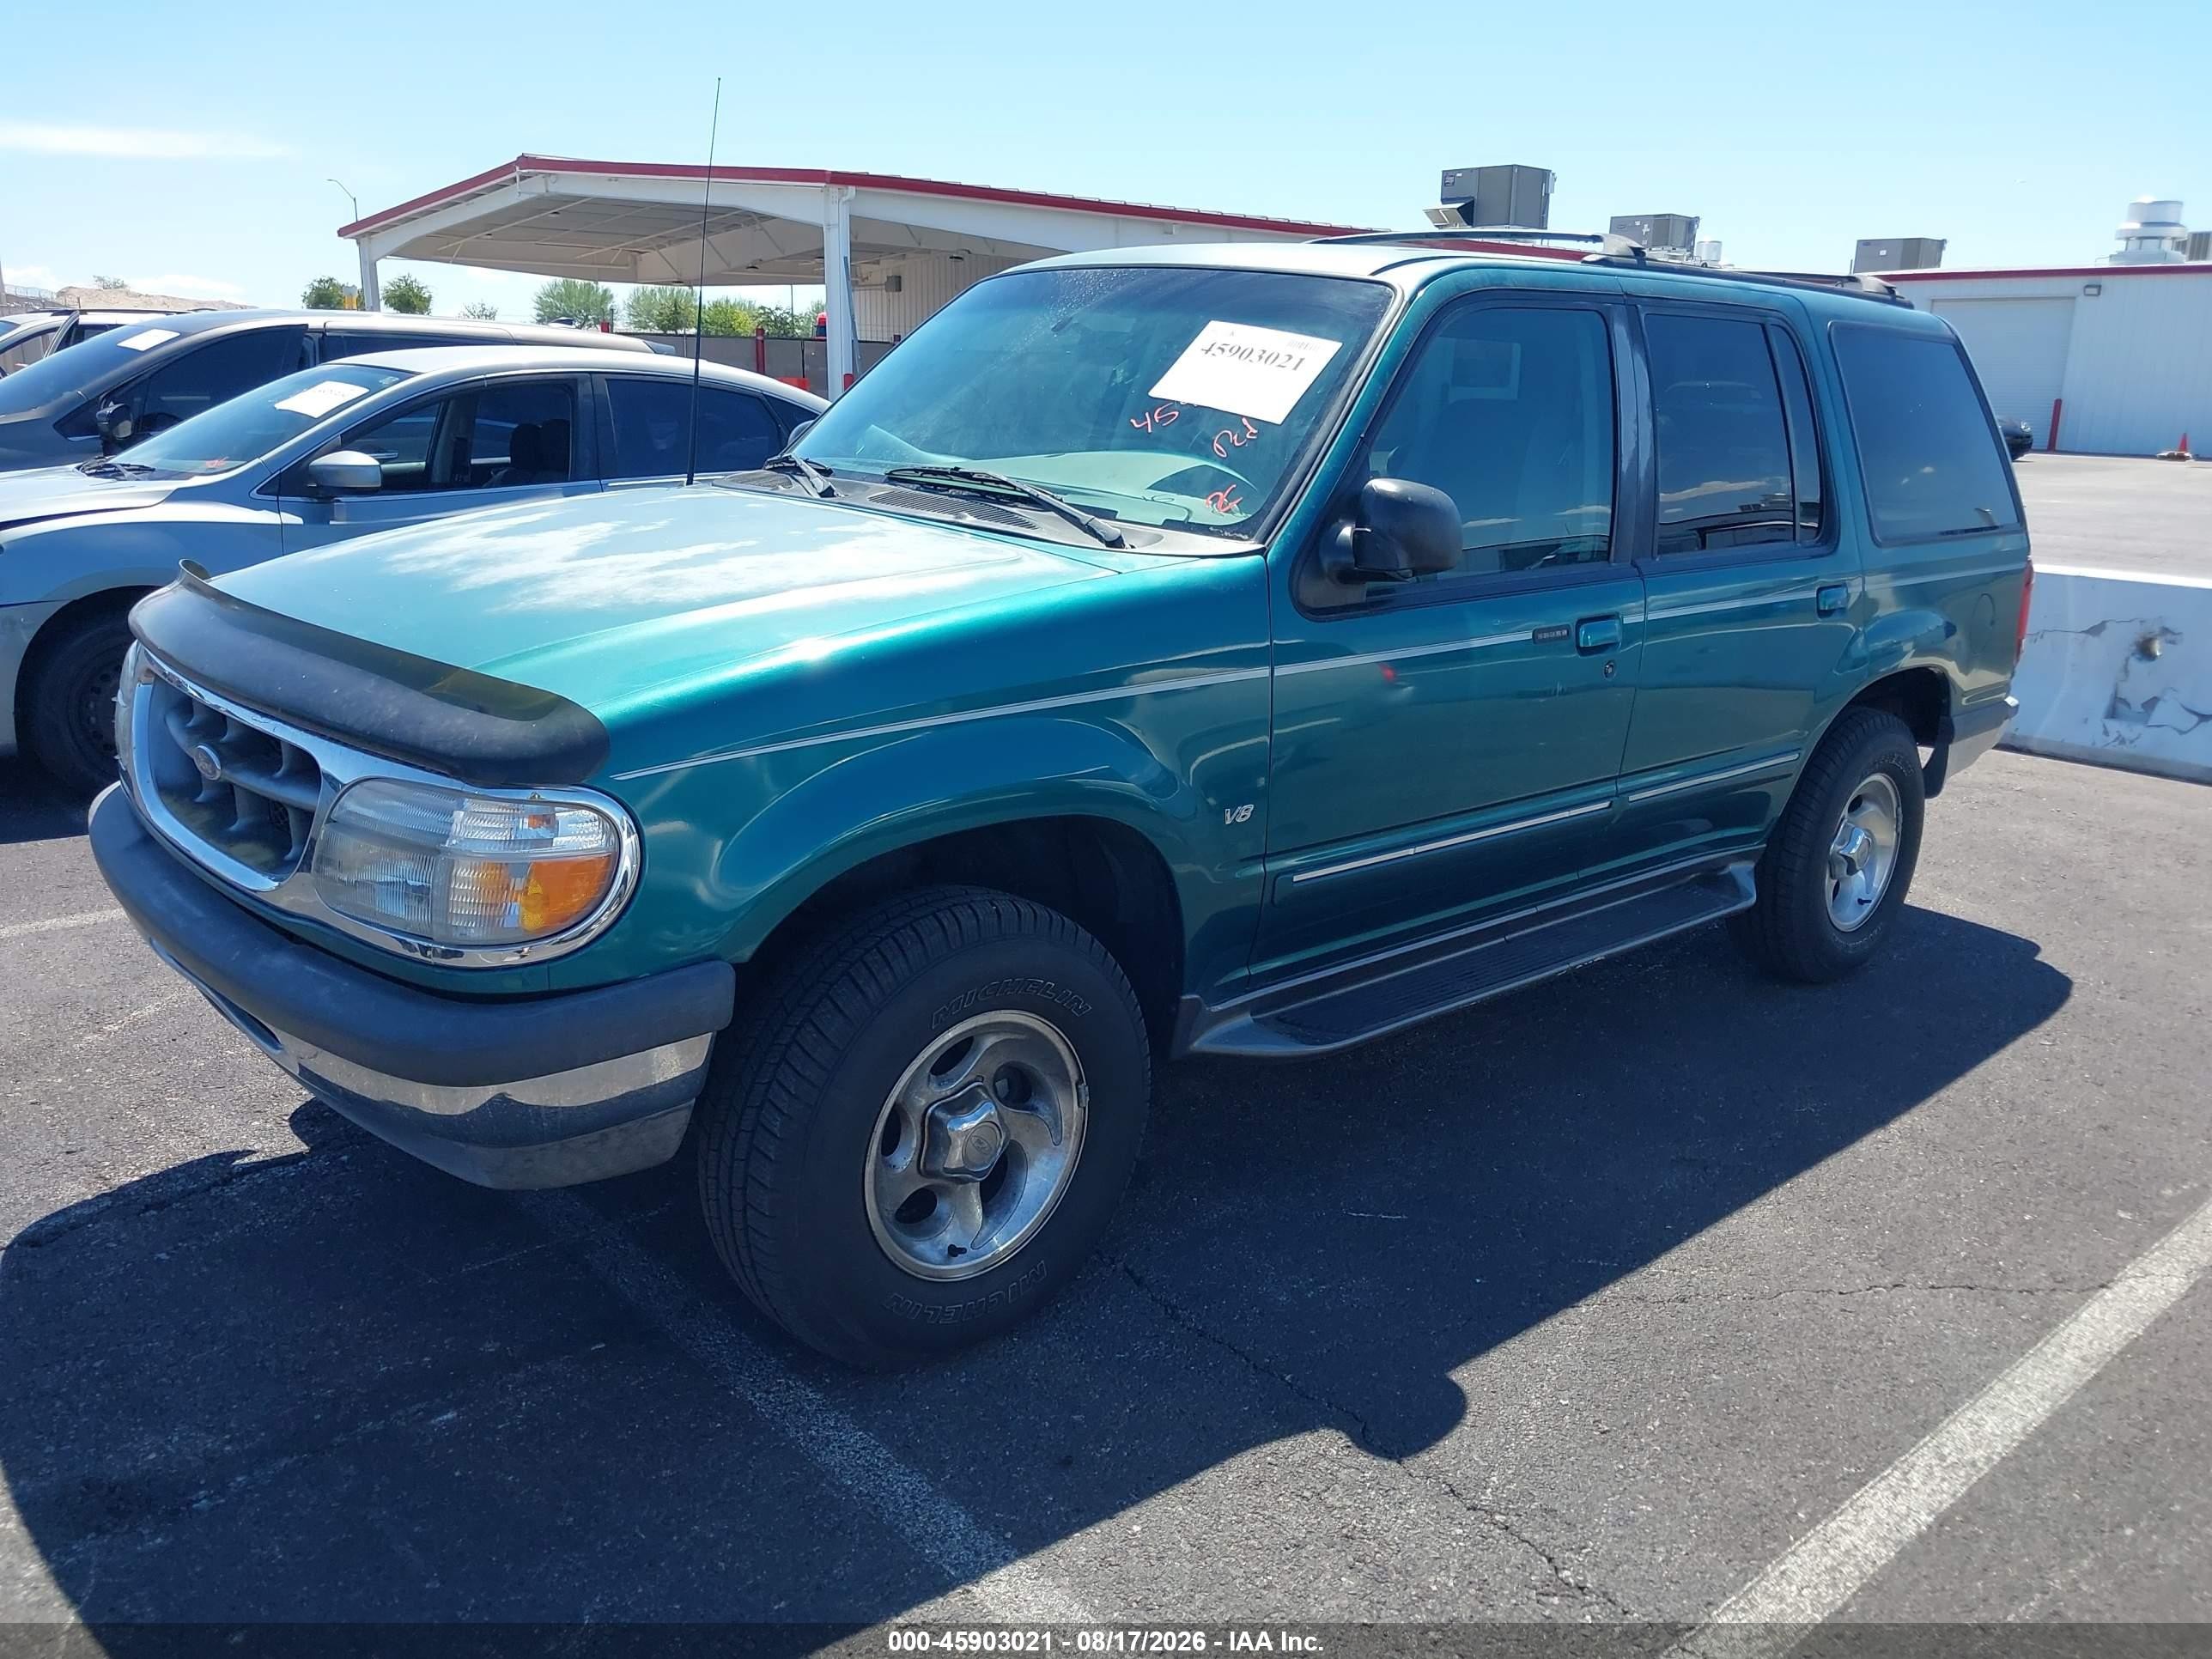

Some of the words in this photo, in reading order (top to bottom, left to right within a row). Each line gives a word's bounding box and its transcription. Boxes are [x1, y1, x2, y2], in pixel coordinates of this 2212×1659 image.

[1200, 341, 1306, 372] 45903021
[1129, 401, 1199, 434] 45
[1224, 803, 1255, 825] V8
[930, 977, 1093, 1030] MICHELIN
[881, 1260, 1049, 1325] MICHELIN
